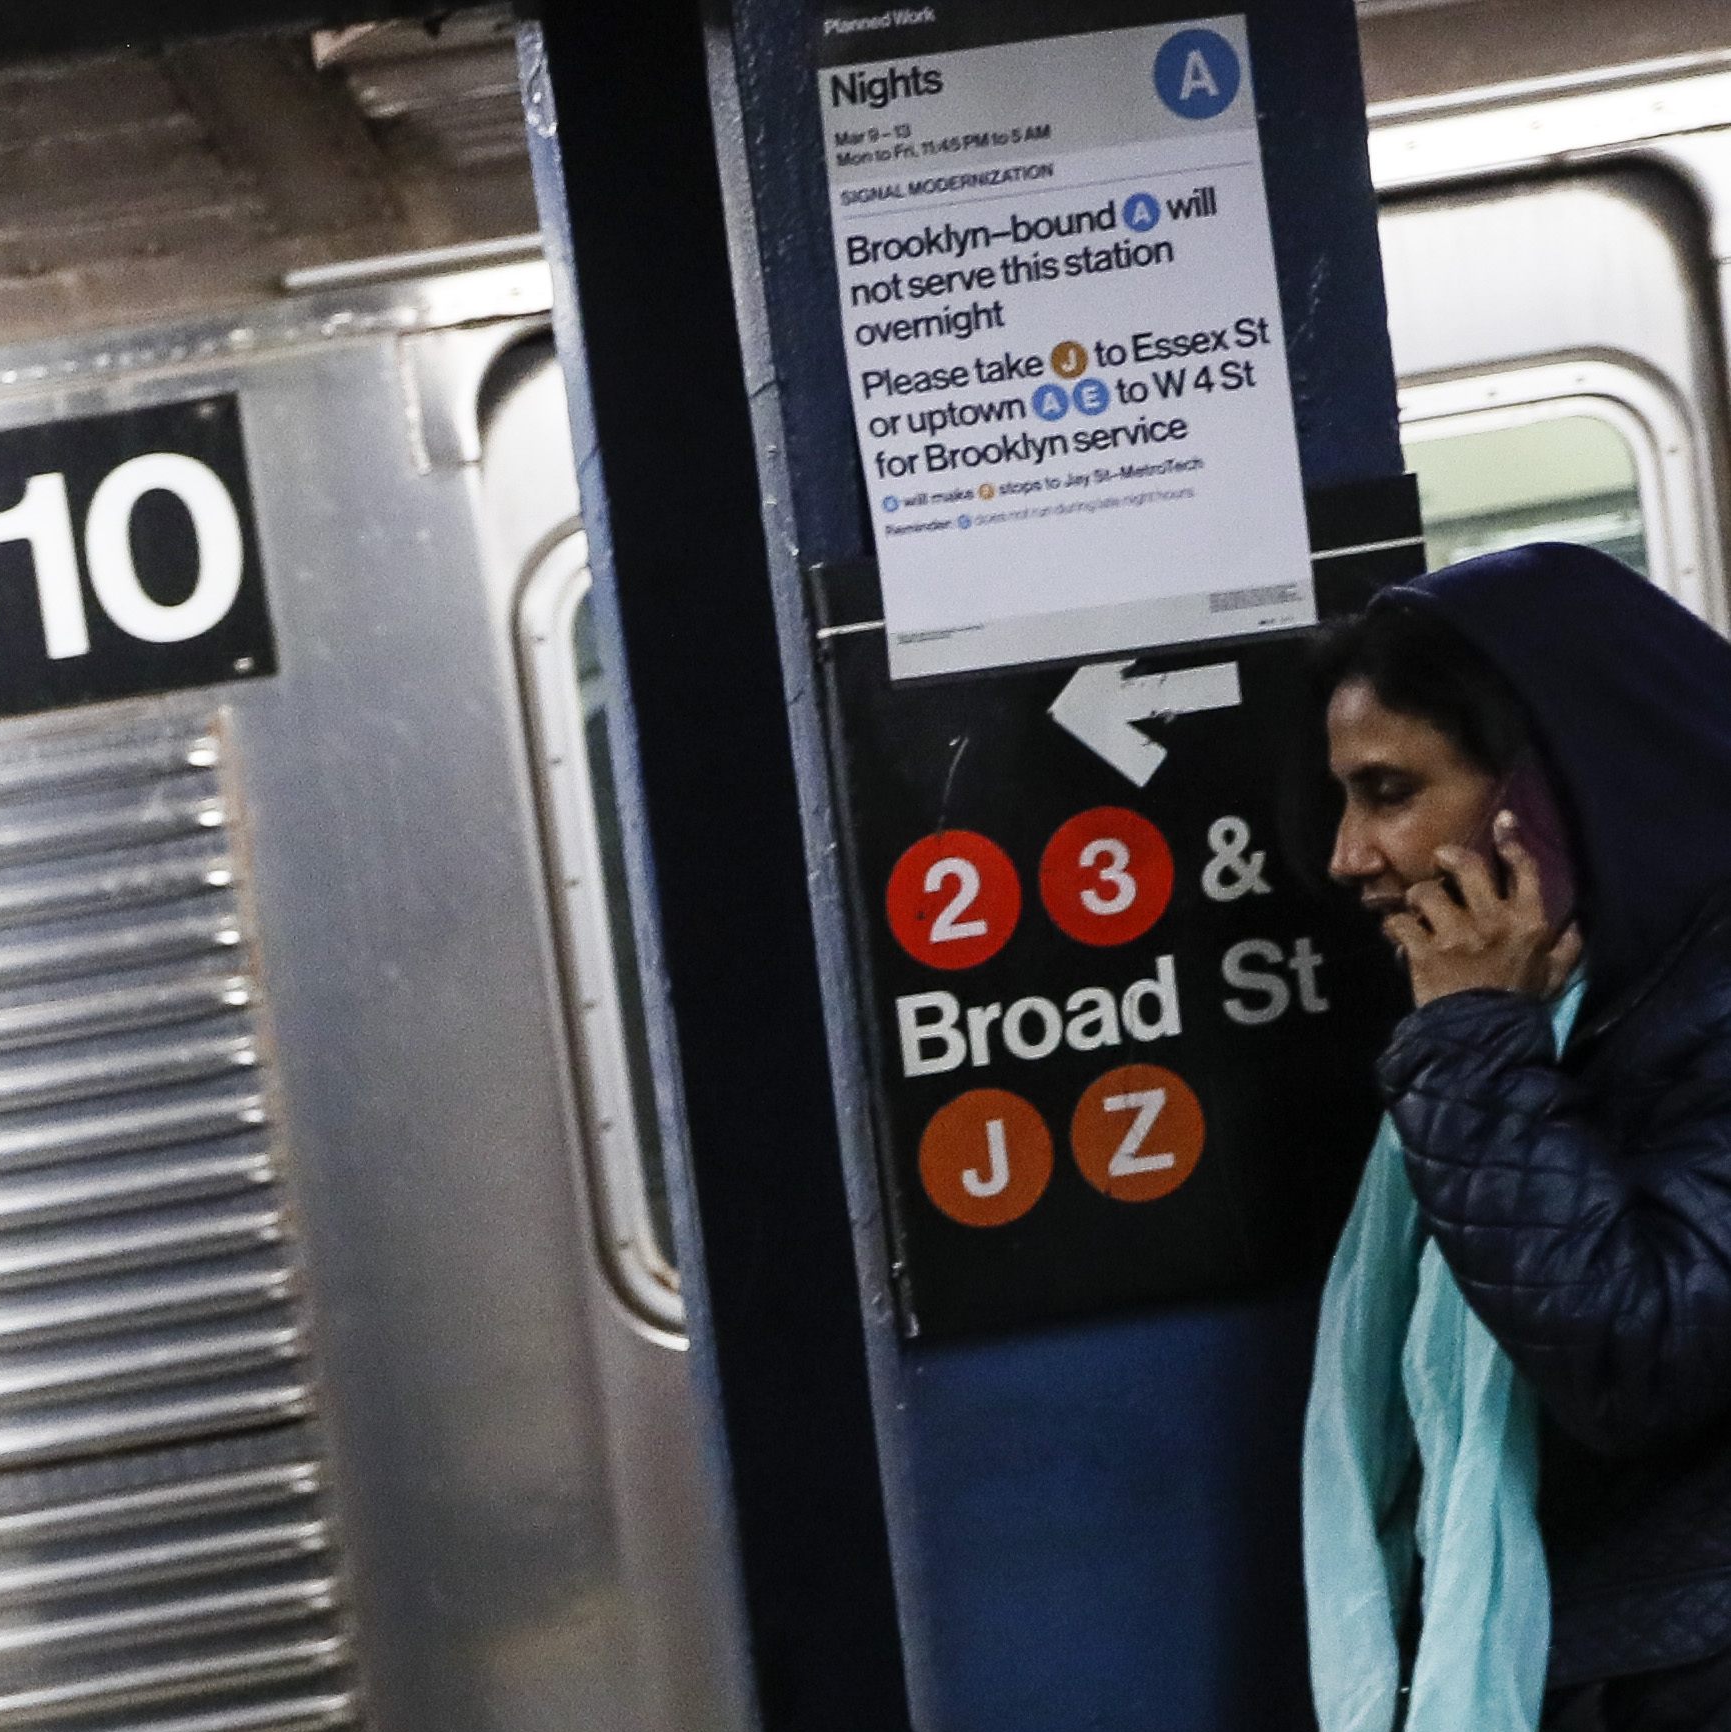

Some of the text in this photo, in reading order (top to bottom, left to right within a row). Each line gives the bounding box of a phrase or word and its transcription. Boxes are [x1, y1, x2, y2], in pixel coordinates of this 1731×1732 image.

[831, 65, 944, 109] Nights
[835, 130, 865, 147] Mar
[837, 151, 874, 166] Mon
[874, 148, 893, 162] to
[963, 132, 990, 150] PM
[991, 131, 1010, 147] to
[1024, 123, 1052, 143] AM
[840, 162, 1055, 206] SIGNAL MODERNIZATION
[1165, 185, 1218, 221] will
[851, 238, 1175, 307] not serve this station
[854, 300, 1006, 347] overnight
[861, 362, 970, 400] Please
[973, 352, 1045, 385] take
[1094, 341, 1128, 368] to
[1131, 328, 1230, 362] Essex
[1233, 316, 1271, 349] St
[868, 412, 902, 438] or
[906, 396, 1028, 437] uptown
[1115, 377, 1150, 407] to
[1151, 366, 1189, 399] W
[1193, 364, 1215, 395] 4
[1219, 359, 1257, 391] St
[874, 414, 1189, 481] for Brooklyn service
[1200, 815, 1273, 902] &
[895, 936, 1330, 1078] Broad St
